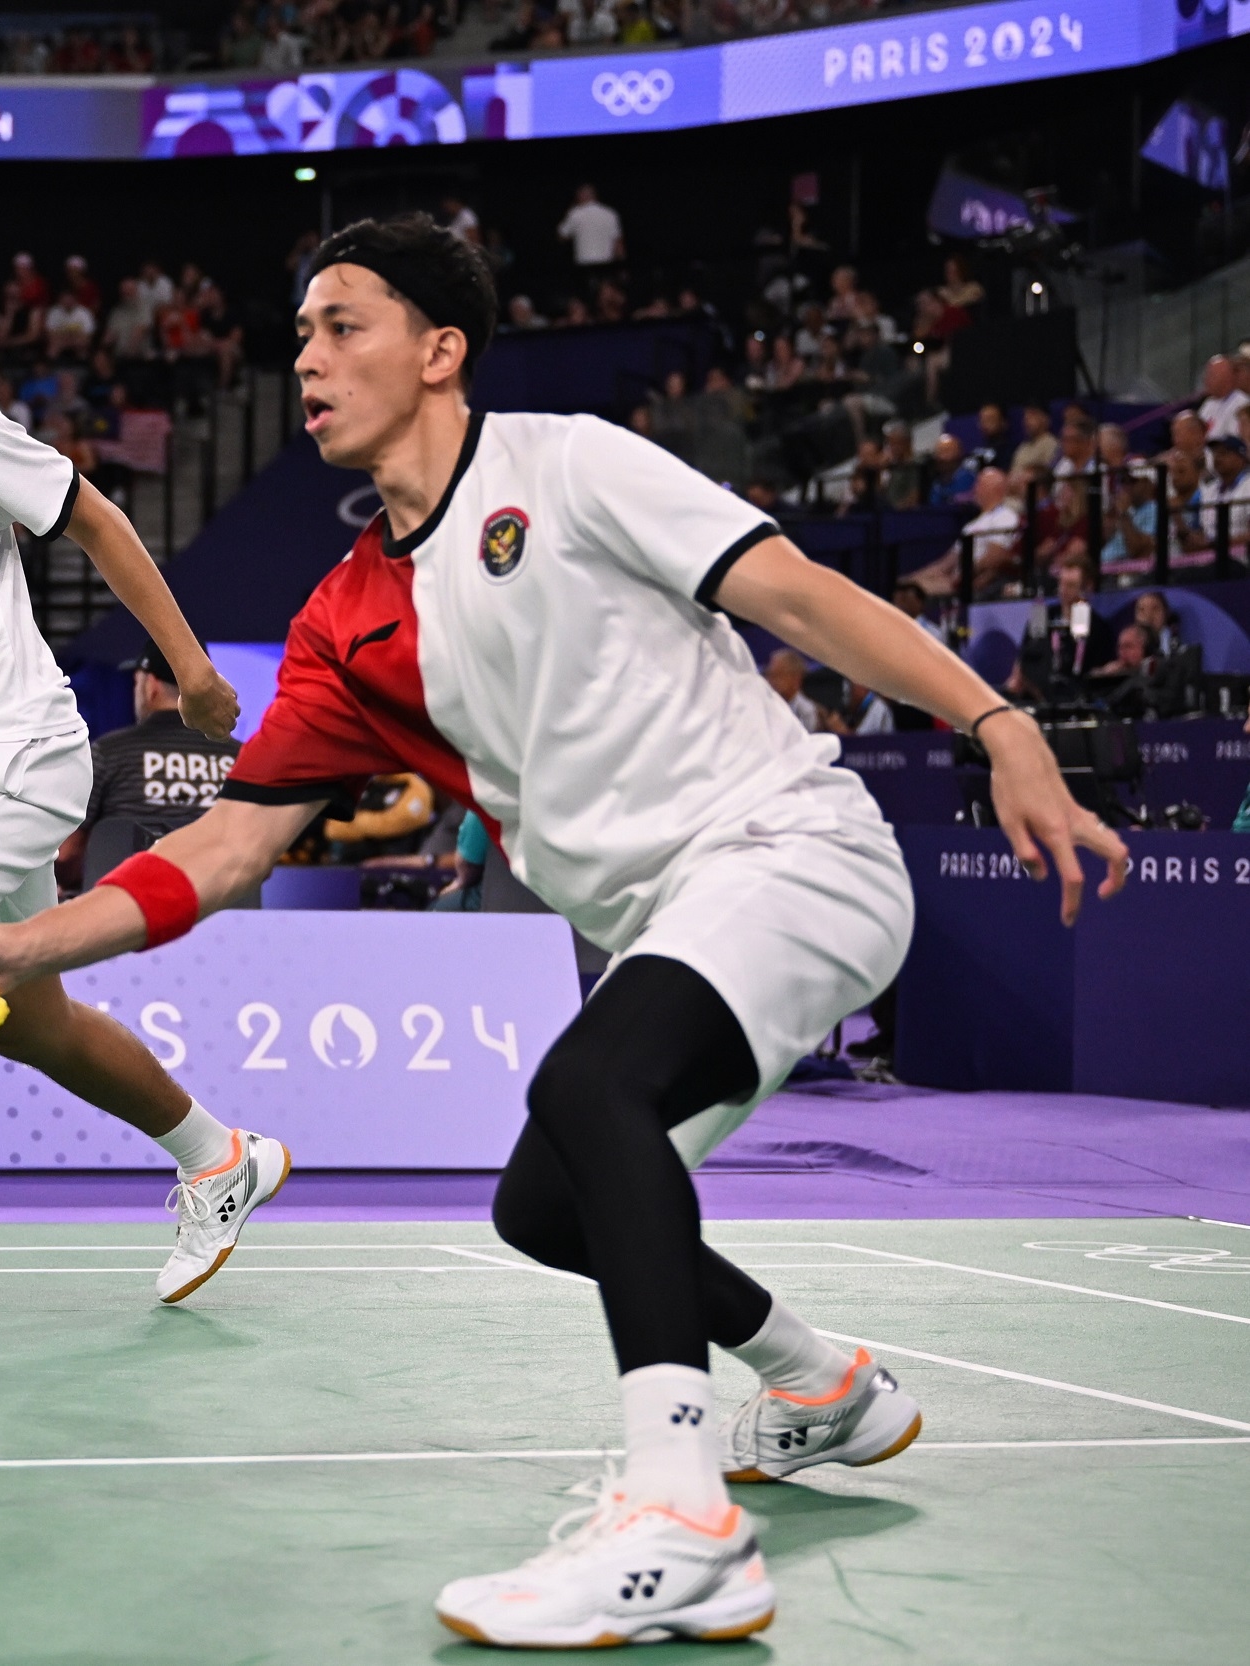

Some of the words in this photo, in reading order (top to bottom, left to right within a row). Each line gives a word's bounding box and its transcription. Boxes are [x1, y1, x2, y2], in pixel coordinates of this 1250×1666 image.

[963, 12, 1083, 68] 2024
[144, 781, 225, 807] 202
[989, 853, 1031, 879] 202
[237, 1002, 520, 1071] 2024
